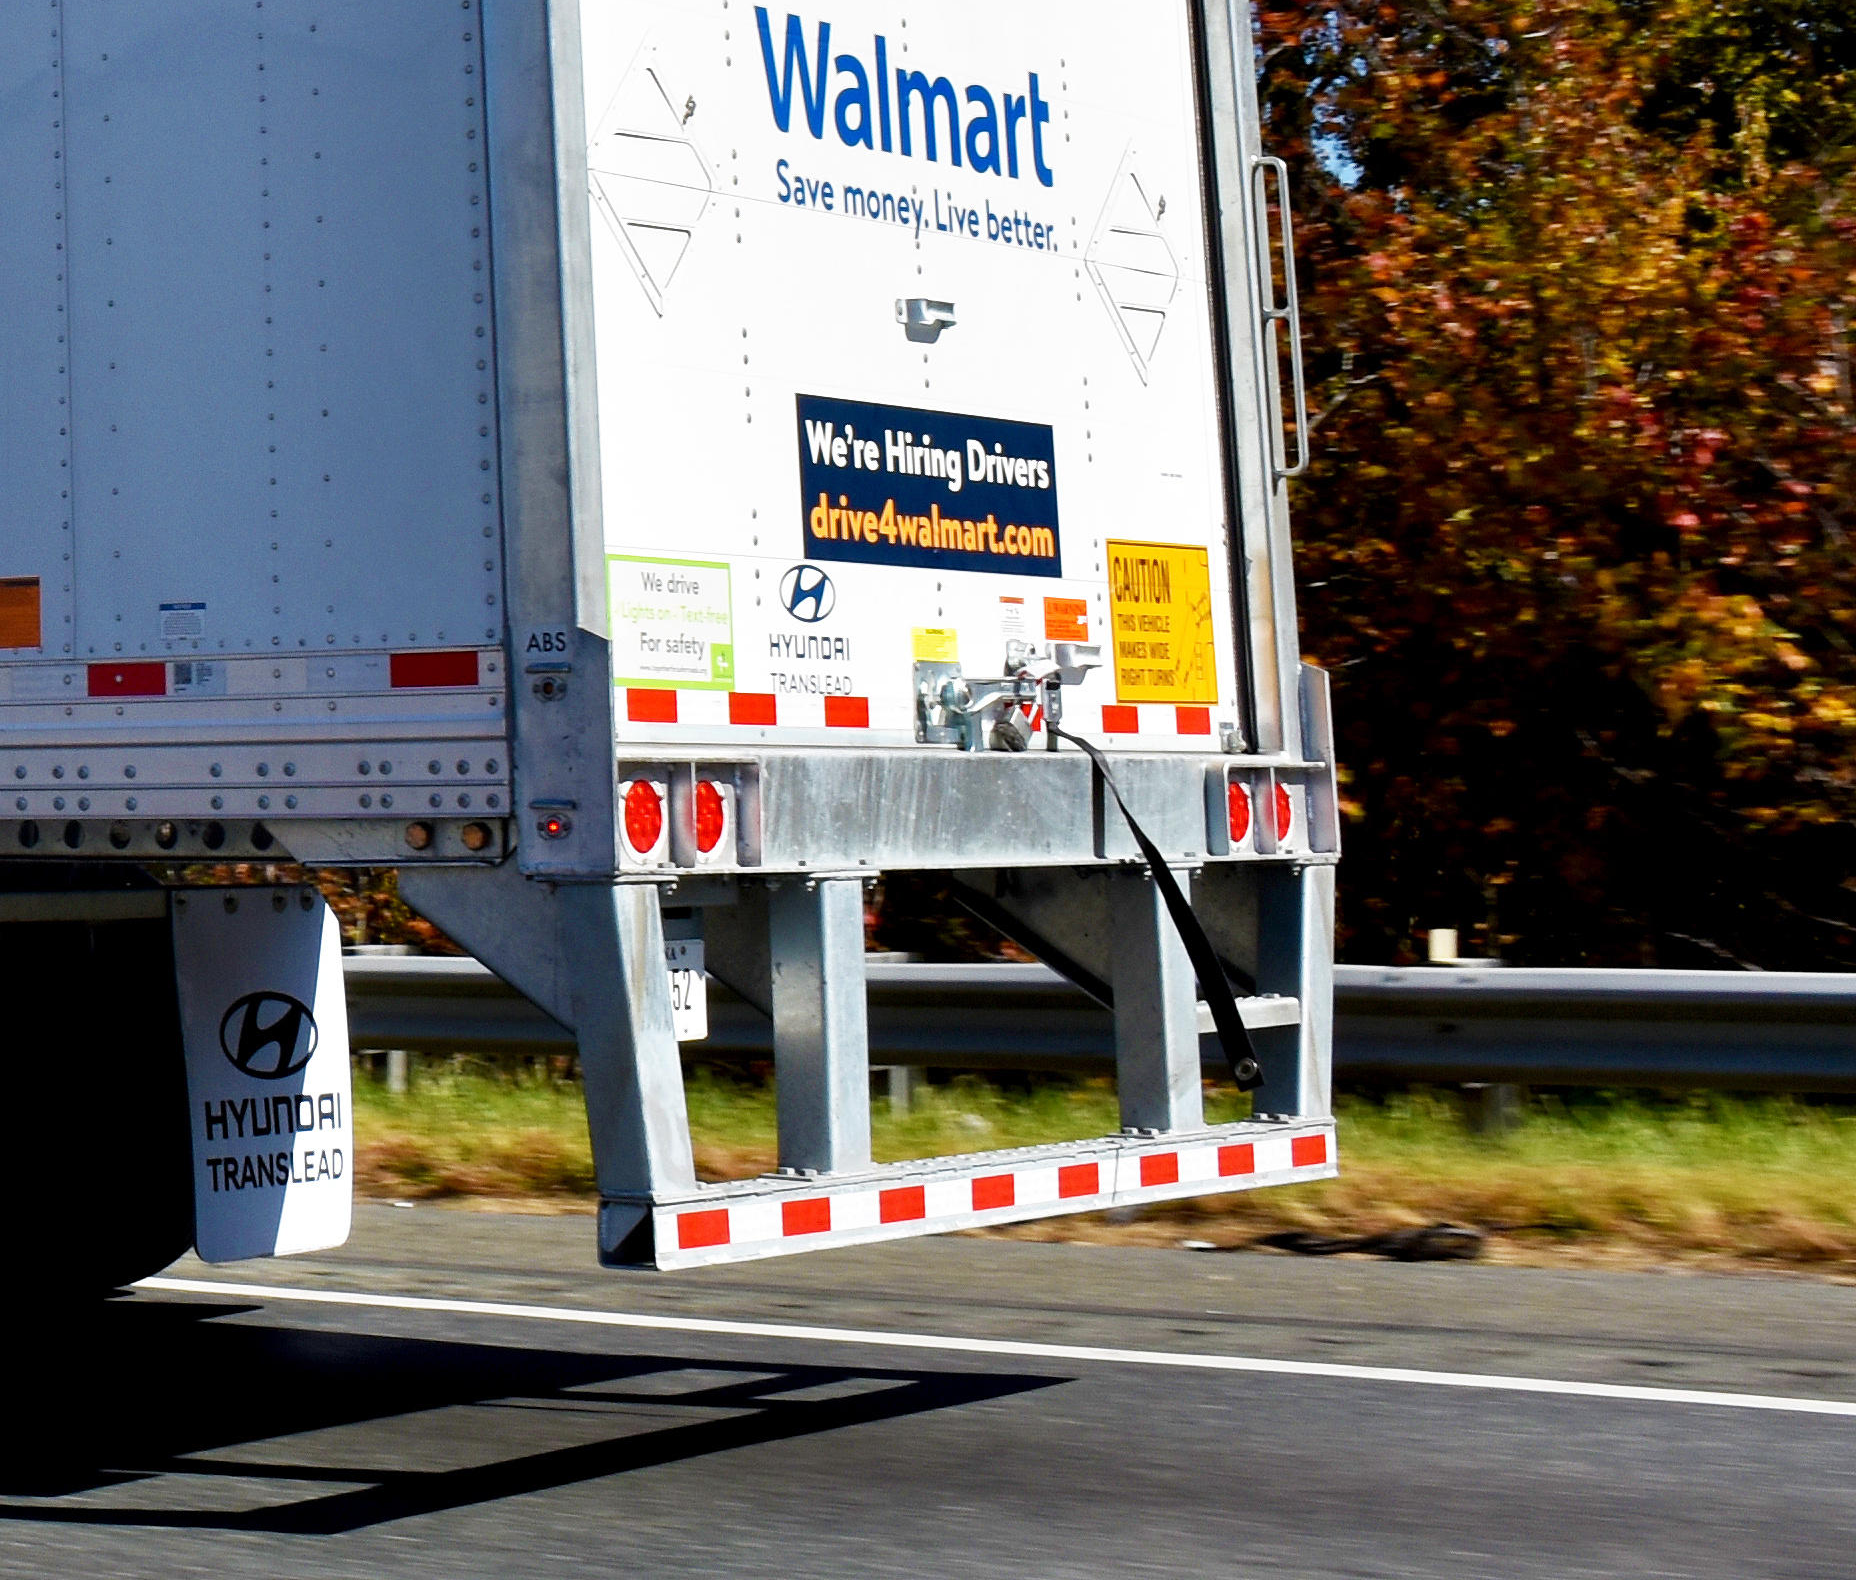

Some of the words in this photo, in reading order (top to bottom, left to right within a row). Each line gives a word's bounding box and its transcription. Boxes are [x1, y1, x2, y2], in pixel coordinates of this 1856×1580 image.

[754, 5, 1053, 188] Walmart
[776, 158, 834, 211] Save
[843, 185, 929, 240] money.
[934, 189, 980, 238] Live
[986, 199, 1058, 252] better.
[804, 419, 880, 472] We're
[884, 429, 962, 493] Hiring
[966, 438, 1050, 490] Drivers
[810, 492, 1055, 558] drive4walmart.com
[640, 571, 663, 593] We
[667, 572, 700, 595] drive
[1113, 556, 1172, 605] CAUTION
[526, 631, 567, 653] ABS
[640, 631, 662, 652] For
[665, 632, 706, 661] safety
[1138, 614, 1171, 634] VEHICLE
[769, 632, 851, 662] HYUNDAI
[769, 672, 853, 696] TRANSLEAD
[205, 1092, 342, 1141] HYUNDAI
[206, 1148, 344, 1193] TRANSLEAD
